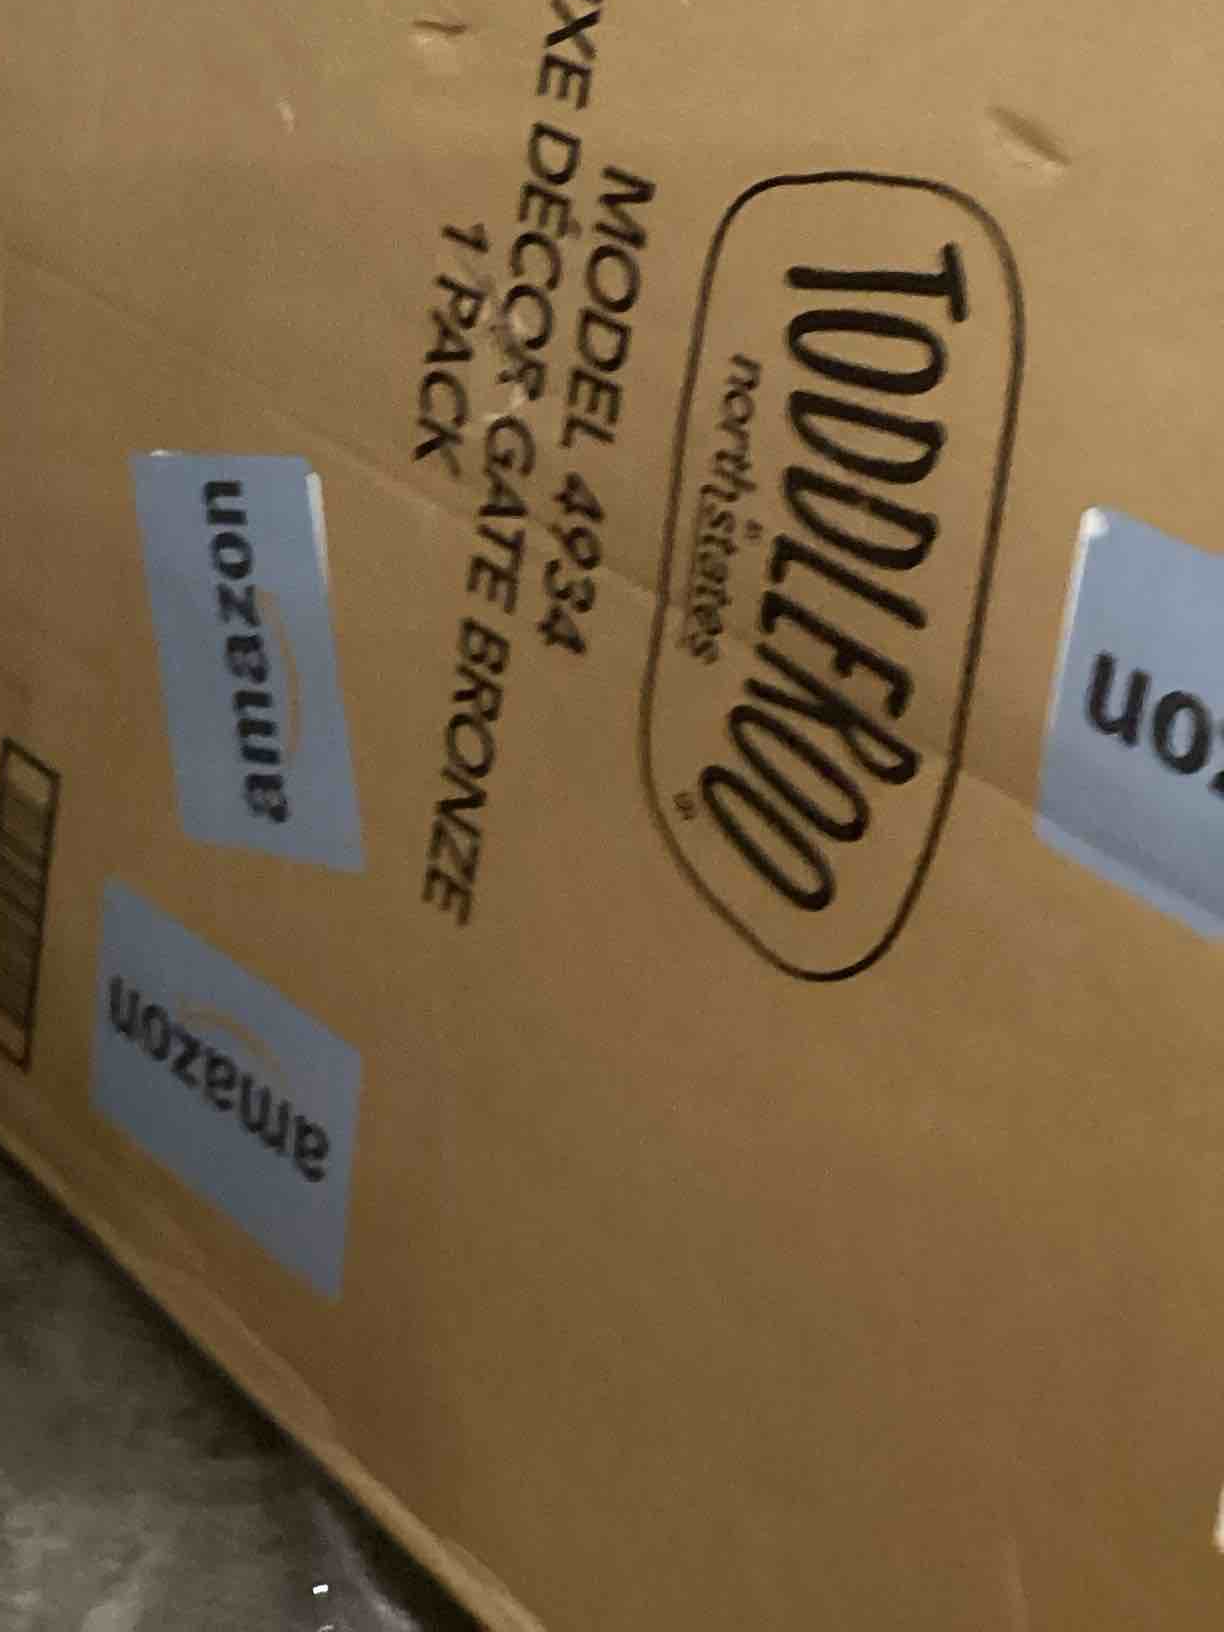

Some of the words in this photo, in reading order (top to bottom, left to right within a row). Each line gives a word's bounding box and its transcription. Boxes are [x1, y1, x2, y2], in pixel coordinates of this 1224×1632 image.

[441, 223, 490, 254] 1
[560, 164, 657, 449] MODEL
[411, 273, 484, 476] PACK
[467, 415, 535, 615] GATE
[538, 472, 605, 655] 4934
[700, 240, 969, 913] TODDLEROO
[203, 480, 291, 824] amazon
[422, 617, 511, 926] BRONZE
[108, 975, 329, 1183] amazon
